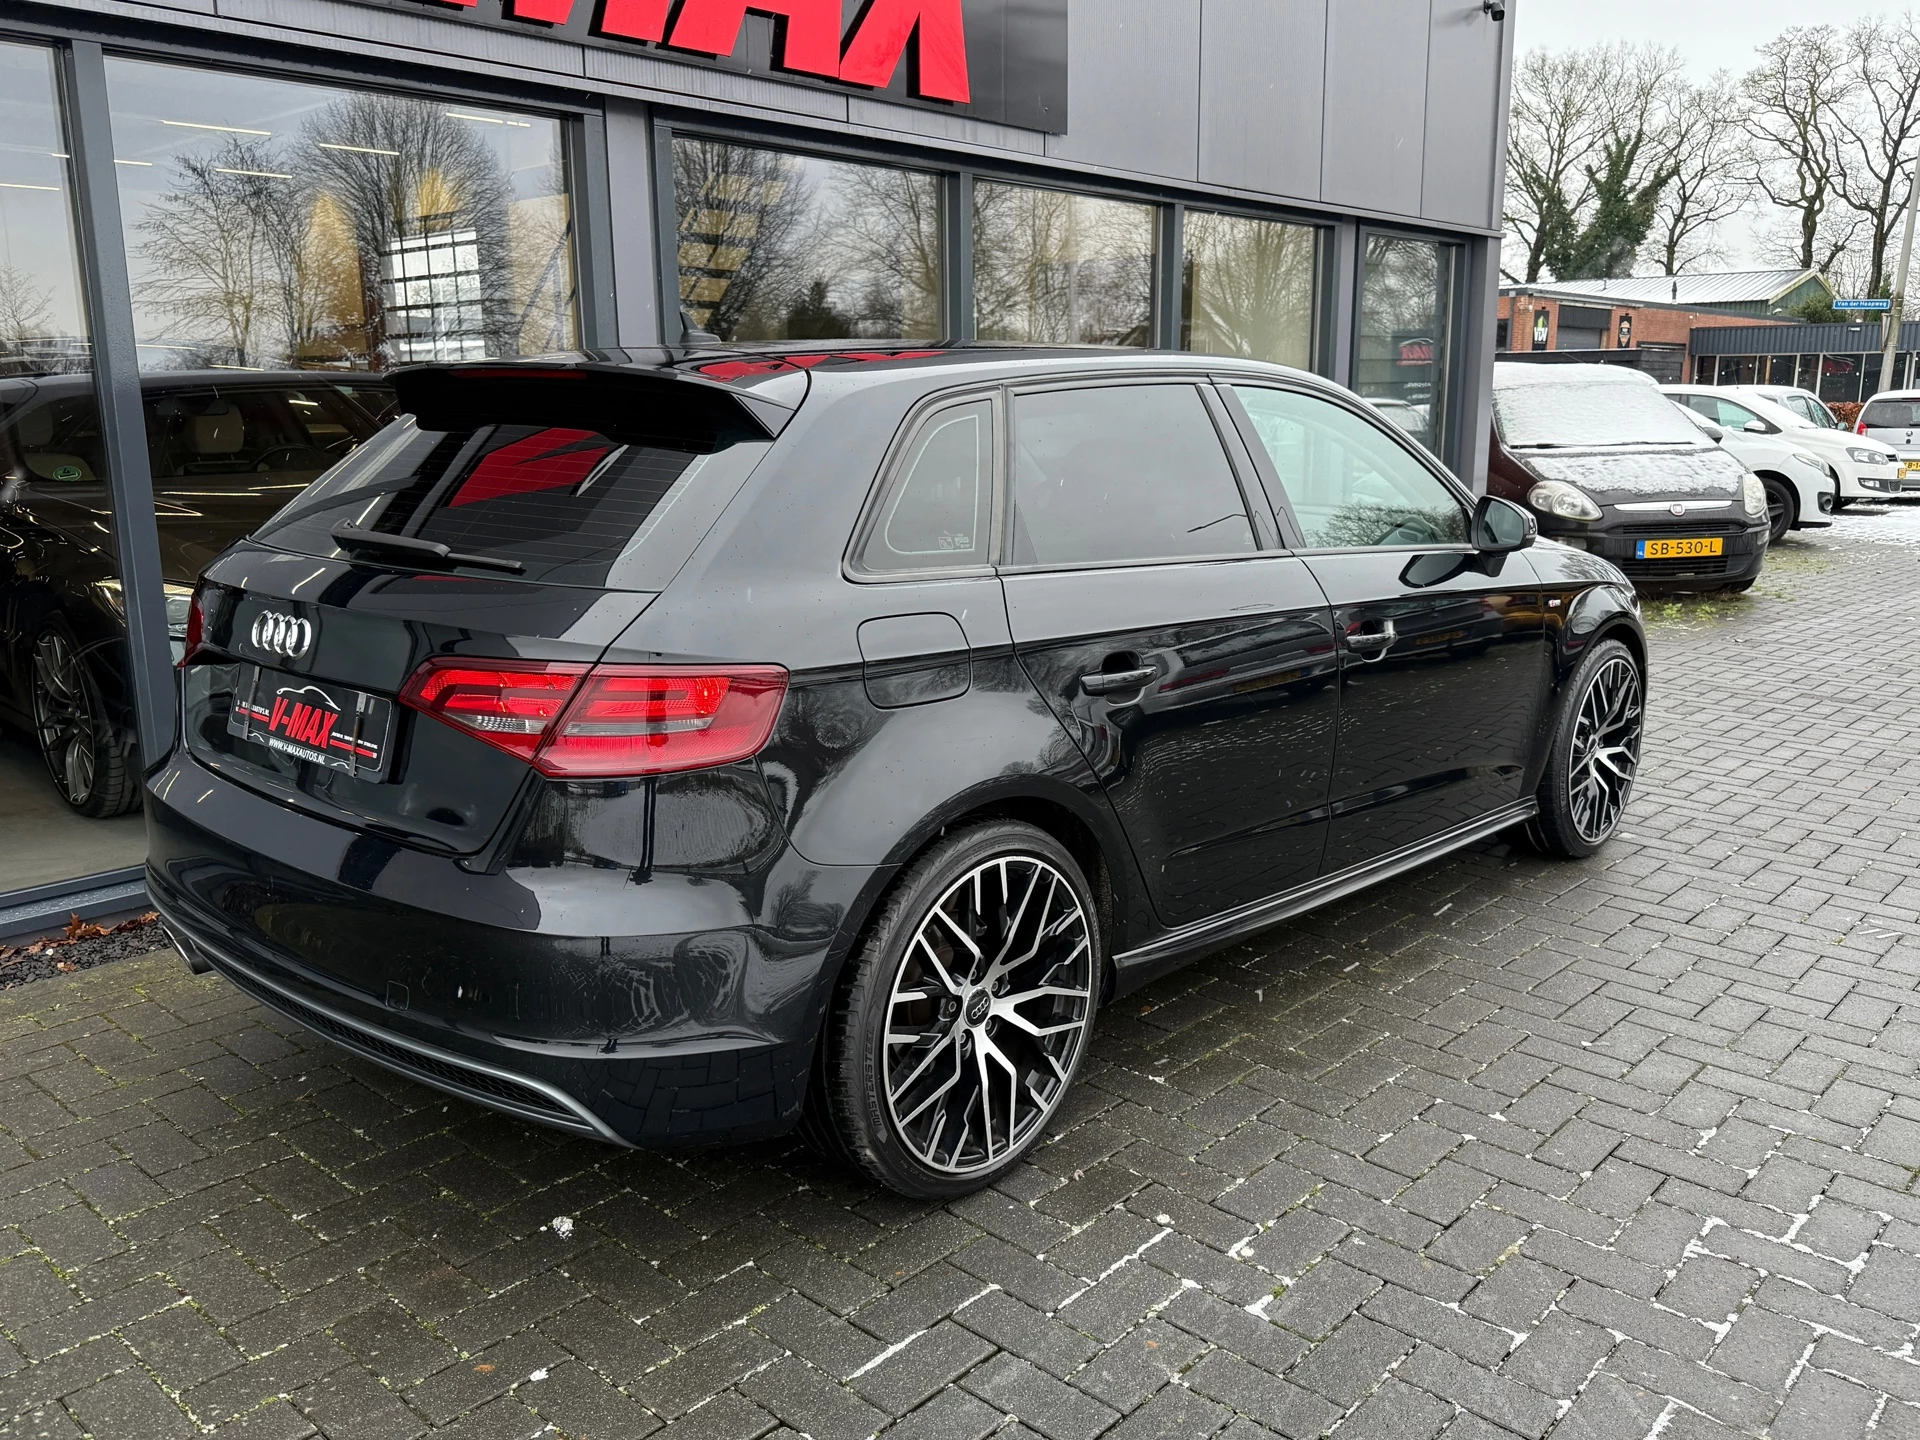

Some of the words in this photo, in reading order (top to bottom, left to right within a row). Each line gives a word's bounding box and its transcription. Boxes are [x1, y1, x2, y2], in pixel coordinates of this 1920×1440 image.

[1650, 541, 1717, 555] SB-530-L
[269, 696, 339, 749] V-MAX
[864, 1027, 882, 1127] MASTERSTEEL
